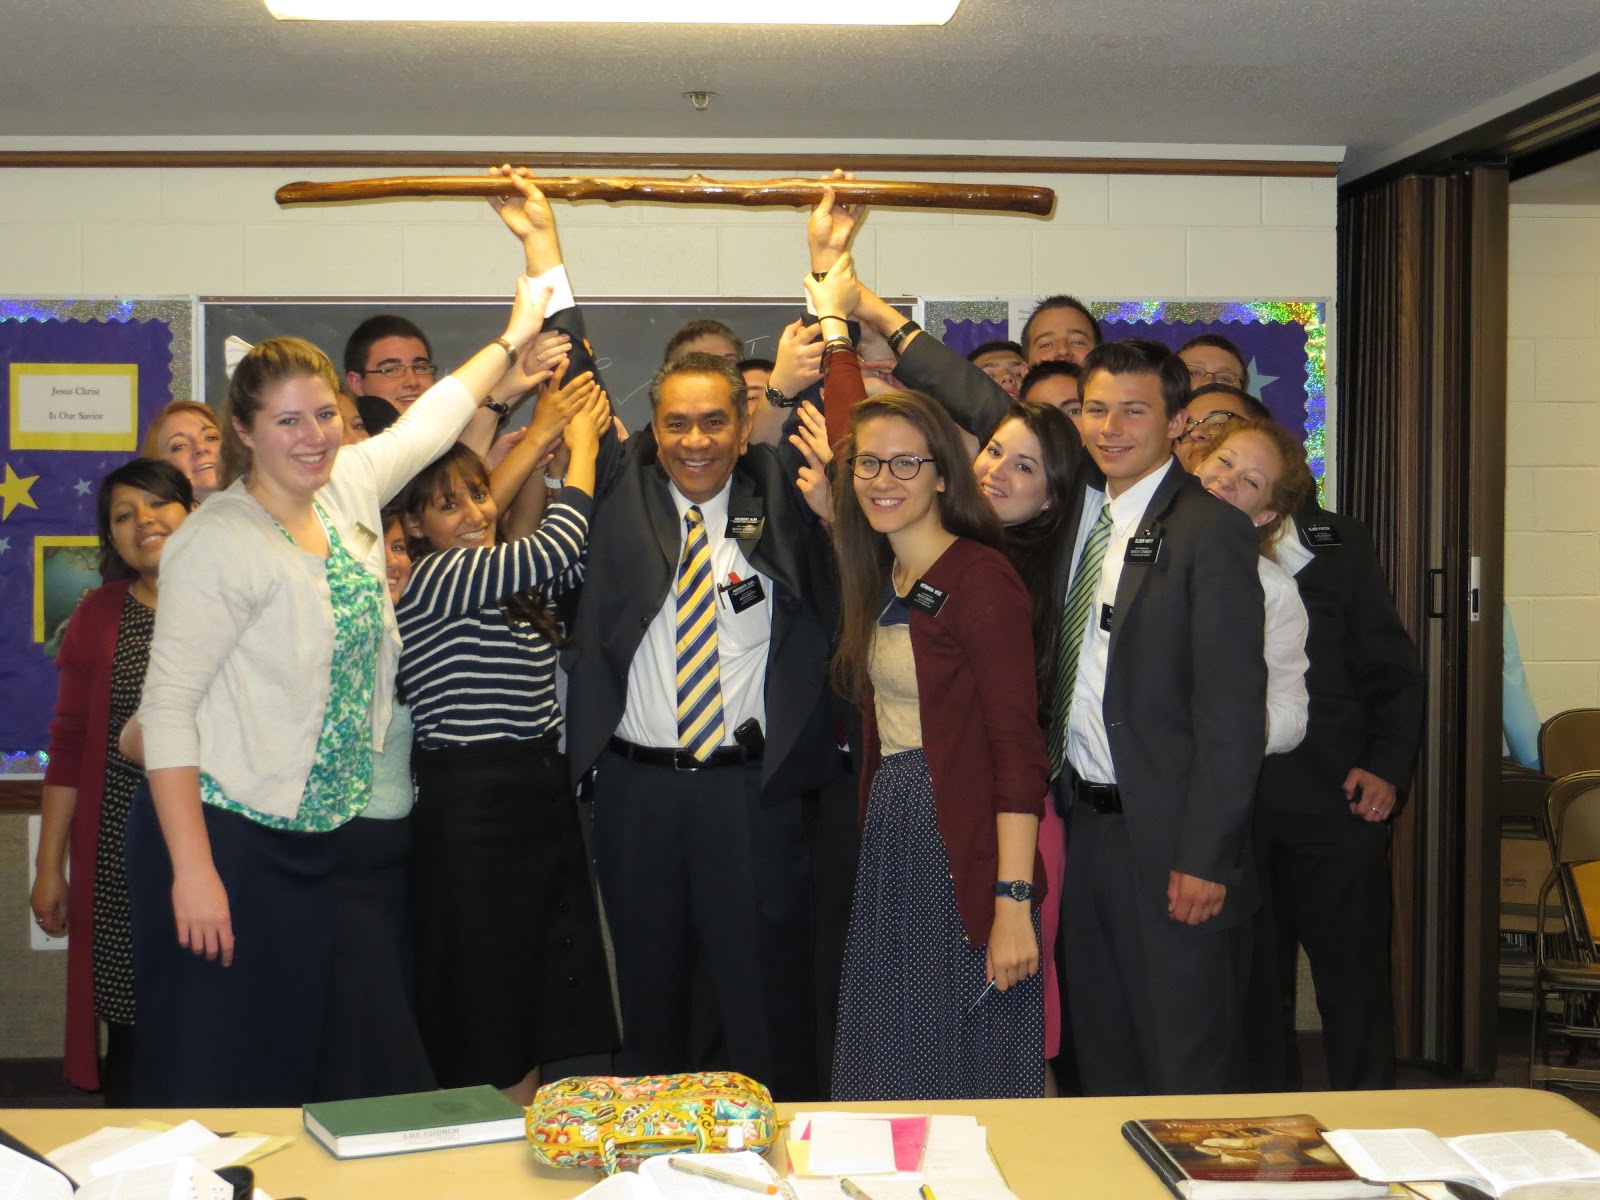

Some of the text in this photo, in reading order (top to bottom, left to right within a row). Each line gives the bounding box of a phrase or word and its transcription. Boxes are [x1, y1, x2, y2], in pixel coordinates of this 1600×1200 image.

[51, 386, 100, 396] Jesus Christ
[49, 411, 104, 420] Is Our Savior
[1163, 1121, 1216, 1130] Preach
[1220, 1121, 1244, 1130] My
[423, 1127, 460, 1137] CHURCH
